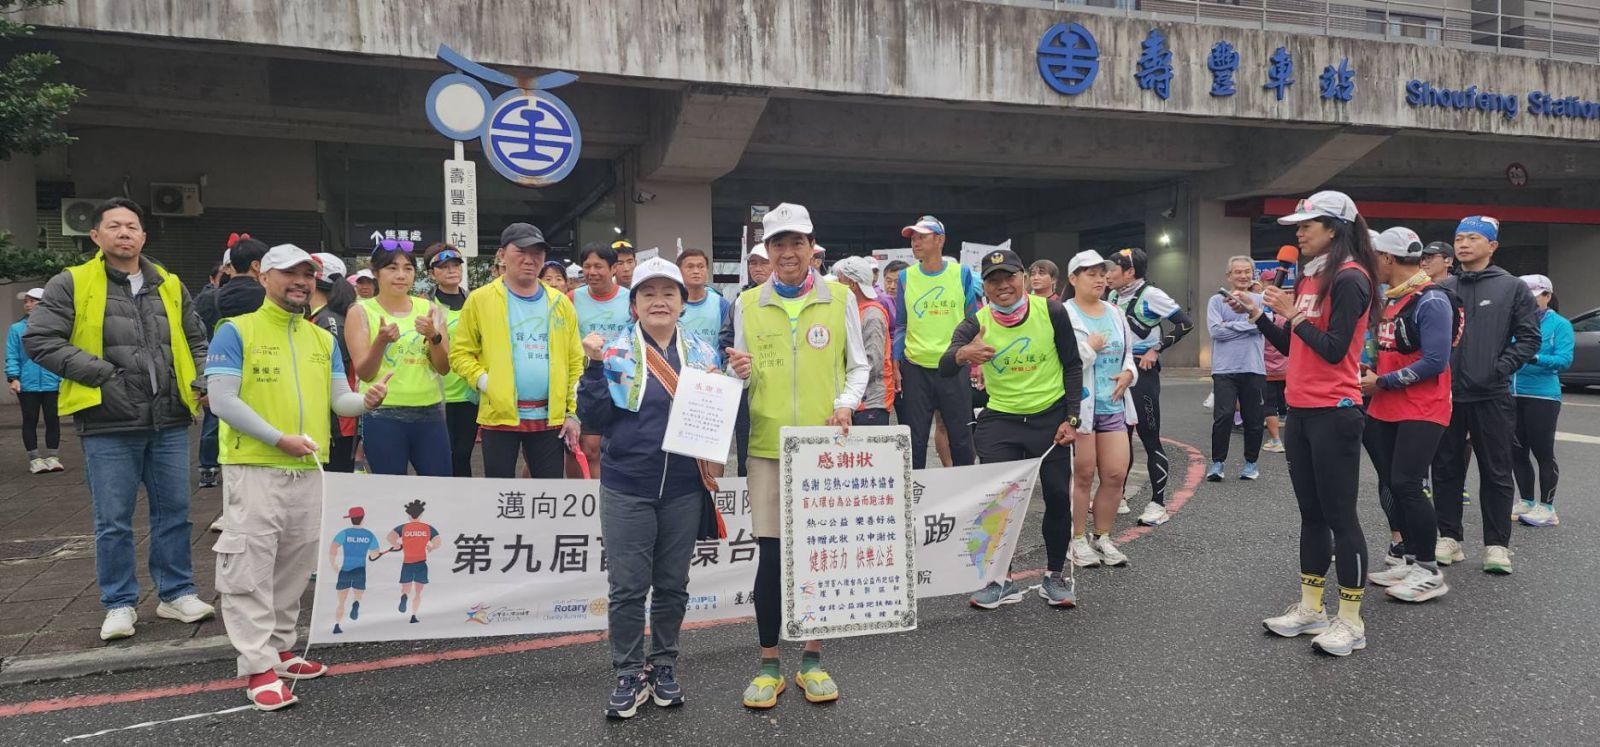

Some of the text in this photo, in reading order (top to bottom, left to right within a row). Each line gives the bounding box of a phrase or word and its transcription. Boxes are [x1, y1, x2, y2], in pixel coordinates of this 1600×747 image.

[1134, 28, 1356, 101] 壽豐車站
[1405, 79, 1519, 119] Shoufeng
[450, 167, 467, 249] 壽豐車站
[817, 451, 874, 469] 感謝狀
[802, 476, 895, 492] 感謝 您熱心協助本協會
[802, 493, 895, 509] 盲人環台為公益而跑活動
[806, 517, 849, 528] 熱心公益
[806, 531, 896, 545] 特贈此狀 以申謝忱
[809, 543, 895, 573] 健康活力 快樂公益
[554, 603, 588, 613] Rotary
